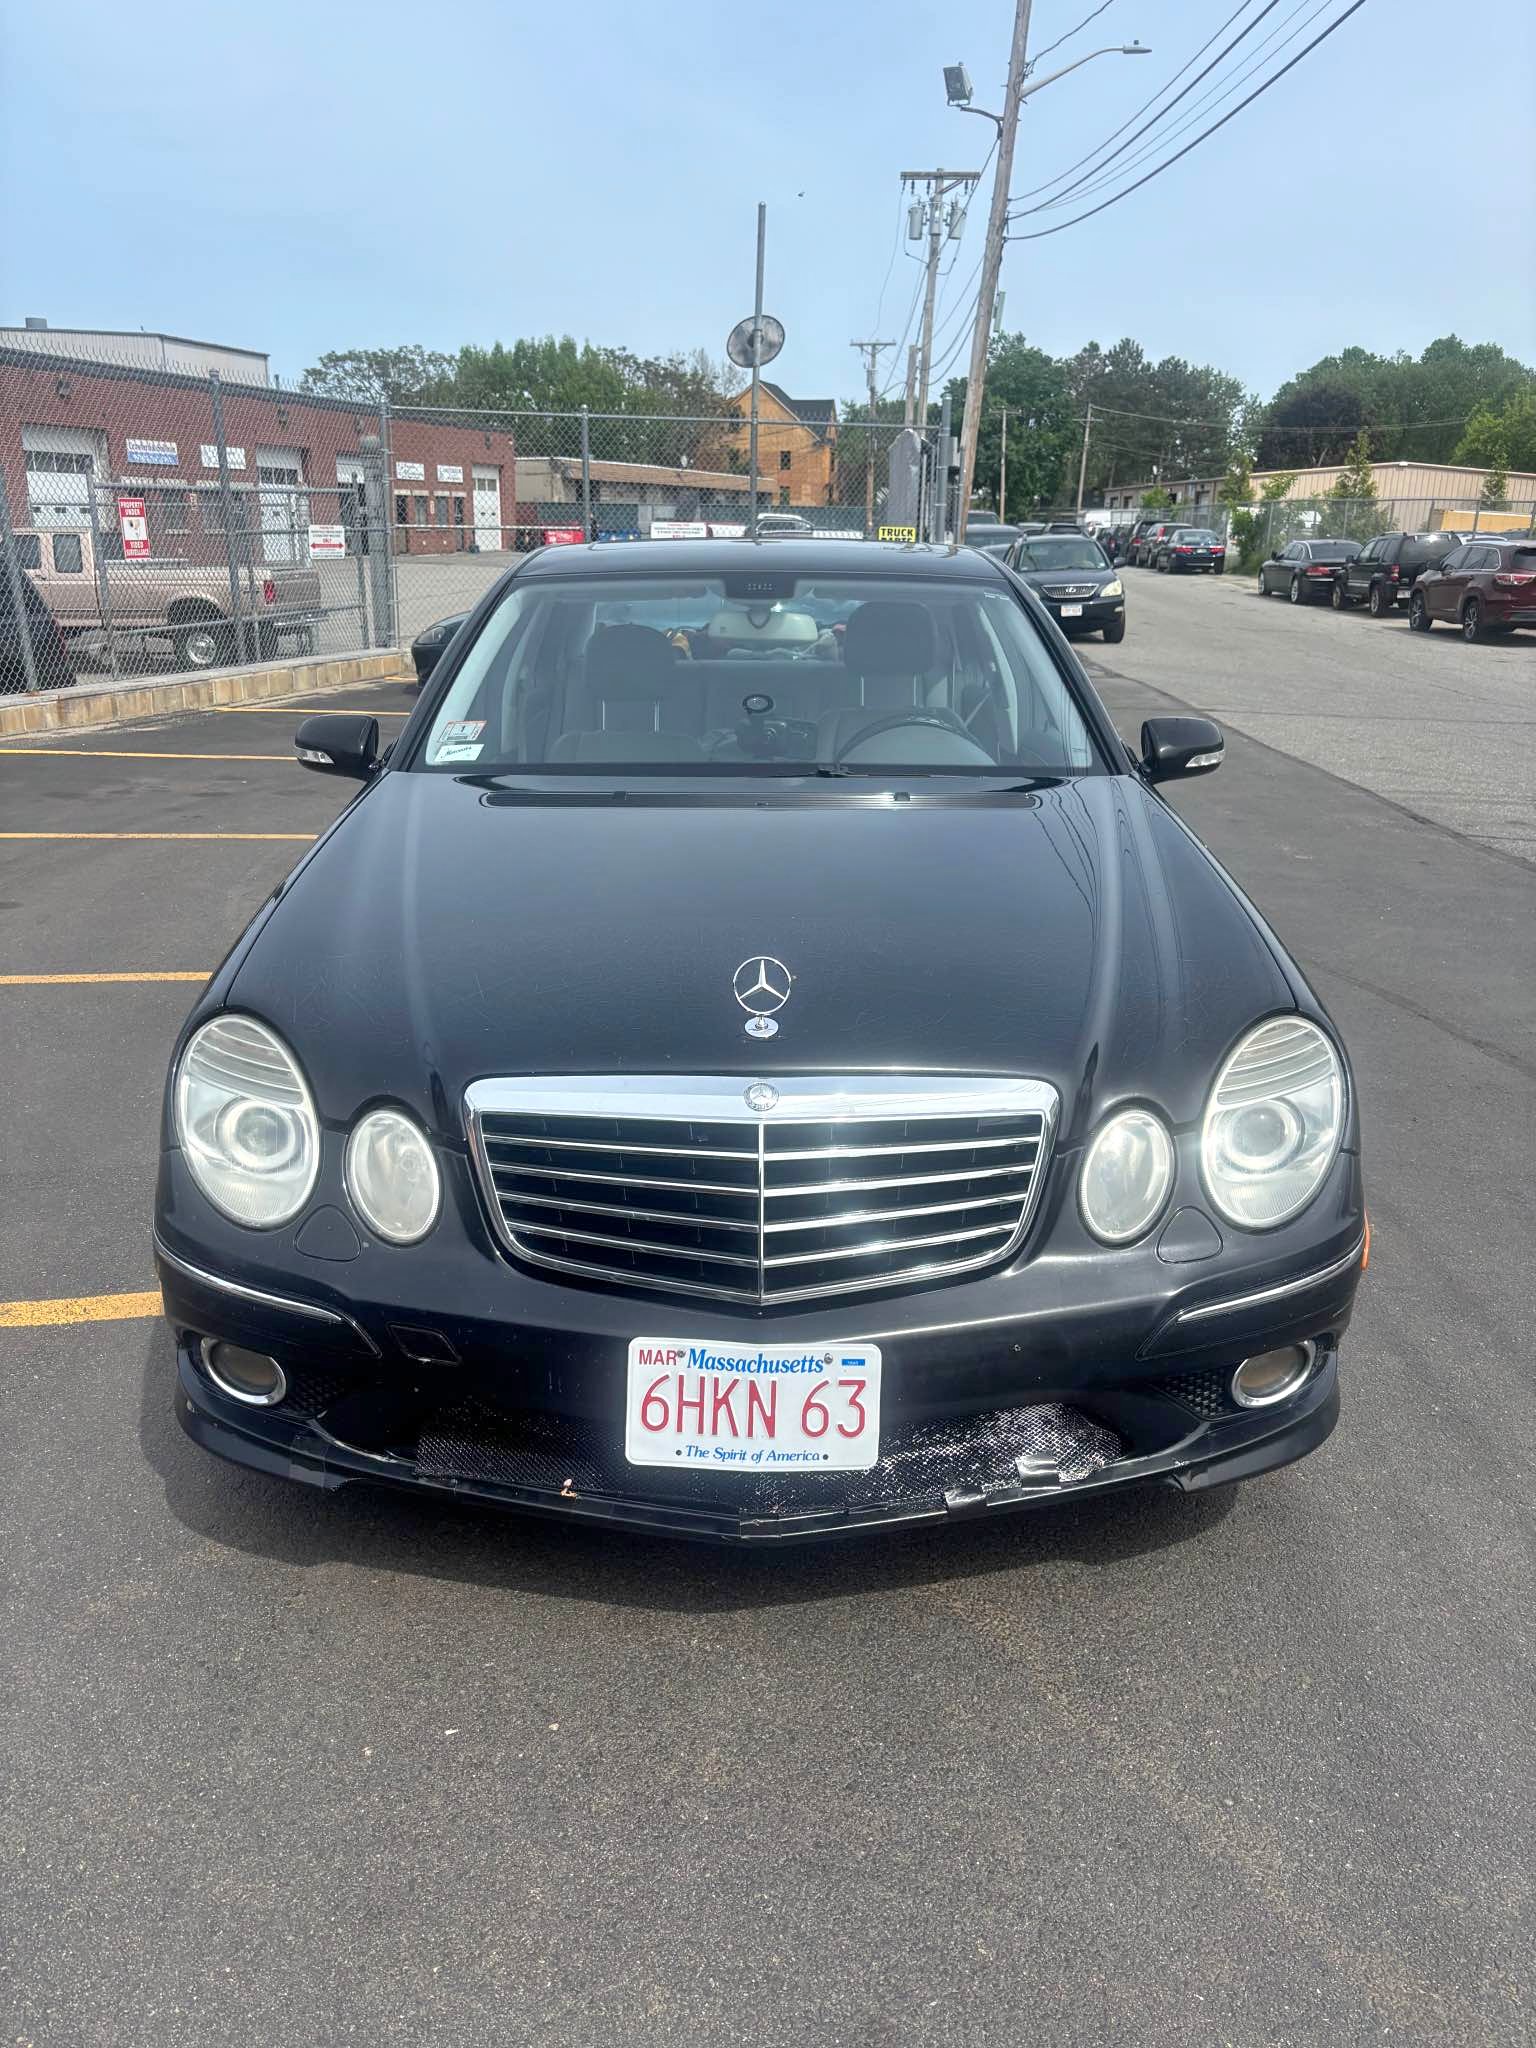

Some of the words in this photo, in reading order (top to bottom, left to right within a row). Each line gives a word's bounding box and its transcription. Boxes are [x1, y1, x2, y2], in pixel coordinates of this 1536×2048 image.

[881, 528, 914, 537] TRUCK
[639, 1348, 678, 1366] MAR
[687, 1348, 824, 1374] Massachusetts
[641, 1374, 777, 1438] 6HKN
[801, 1380, 867, 1438] 63
[686, 1445, 710, 1458] The
[713, 1447, 748, 1463] Spirit
[751, 1449, 763, 1465] of
[766, 1449, 821, 1462] America
